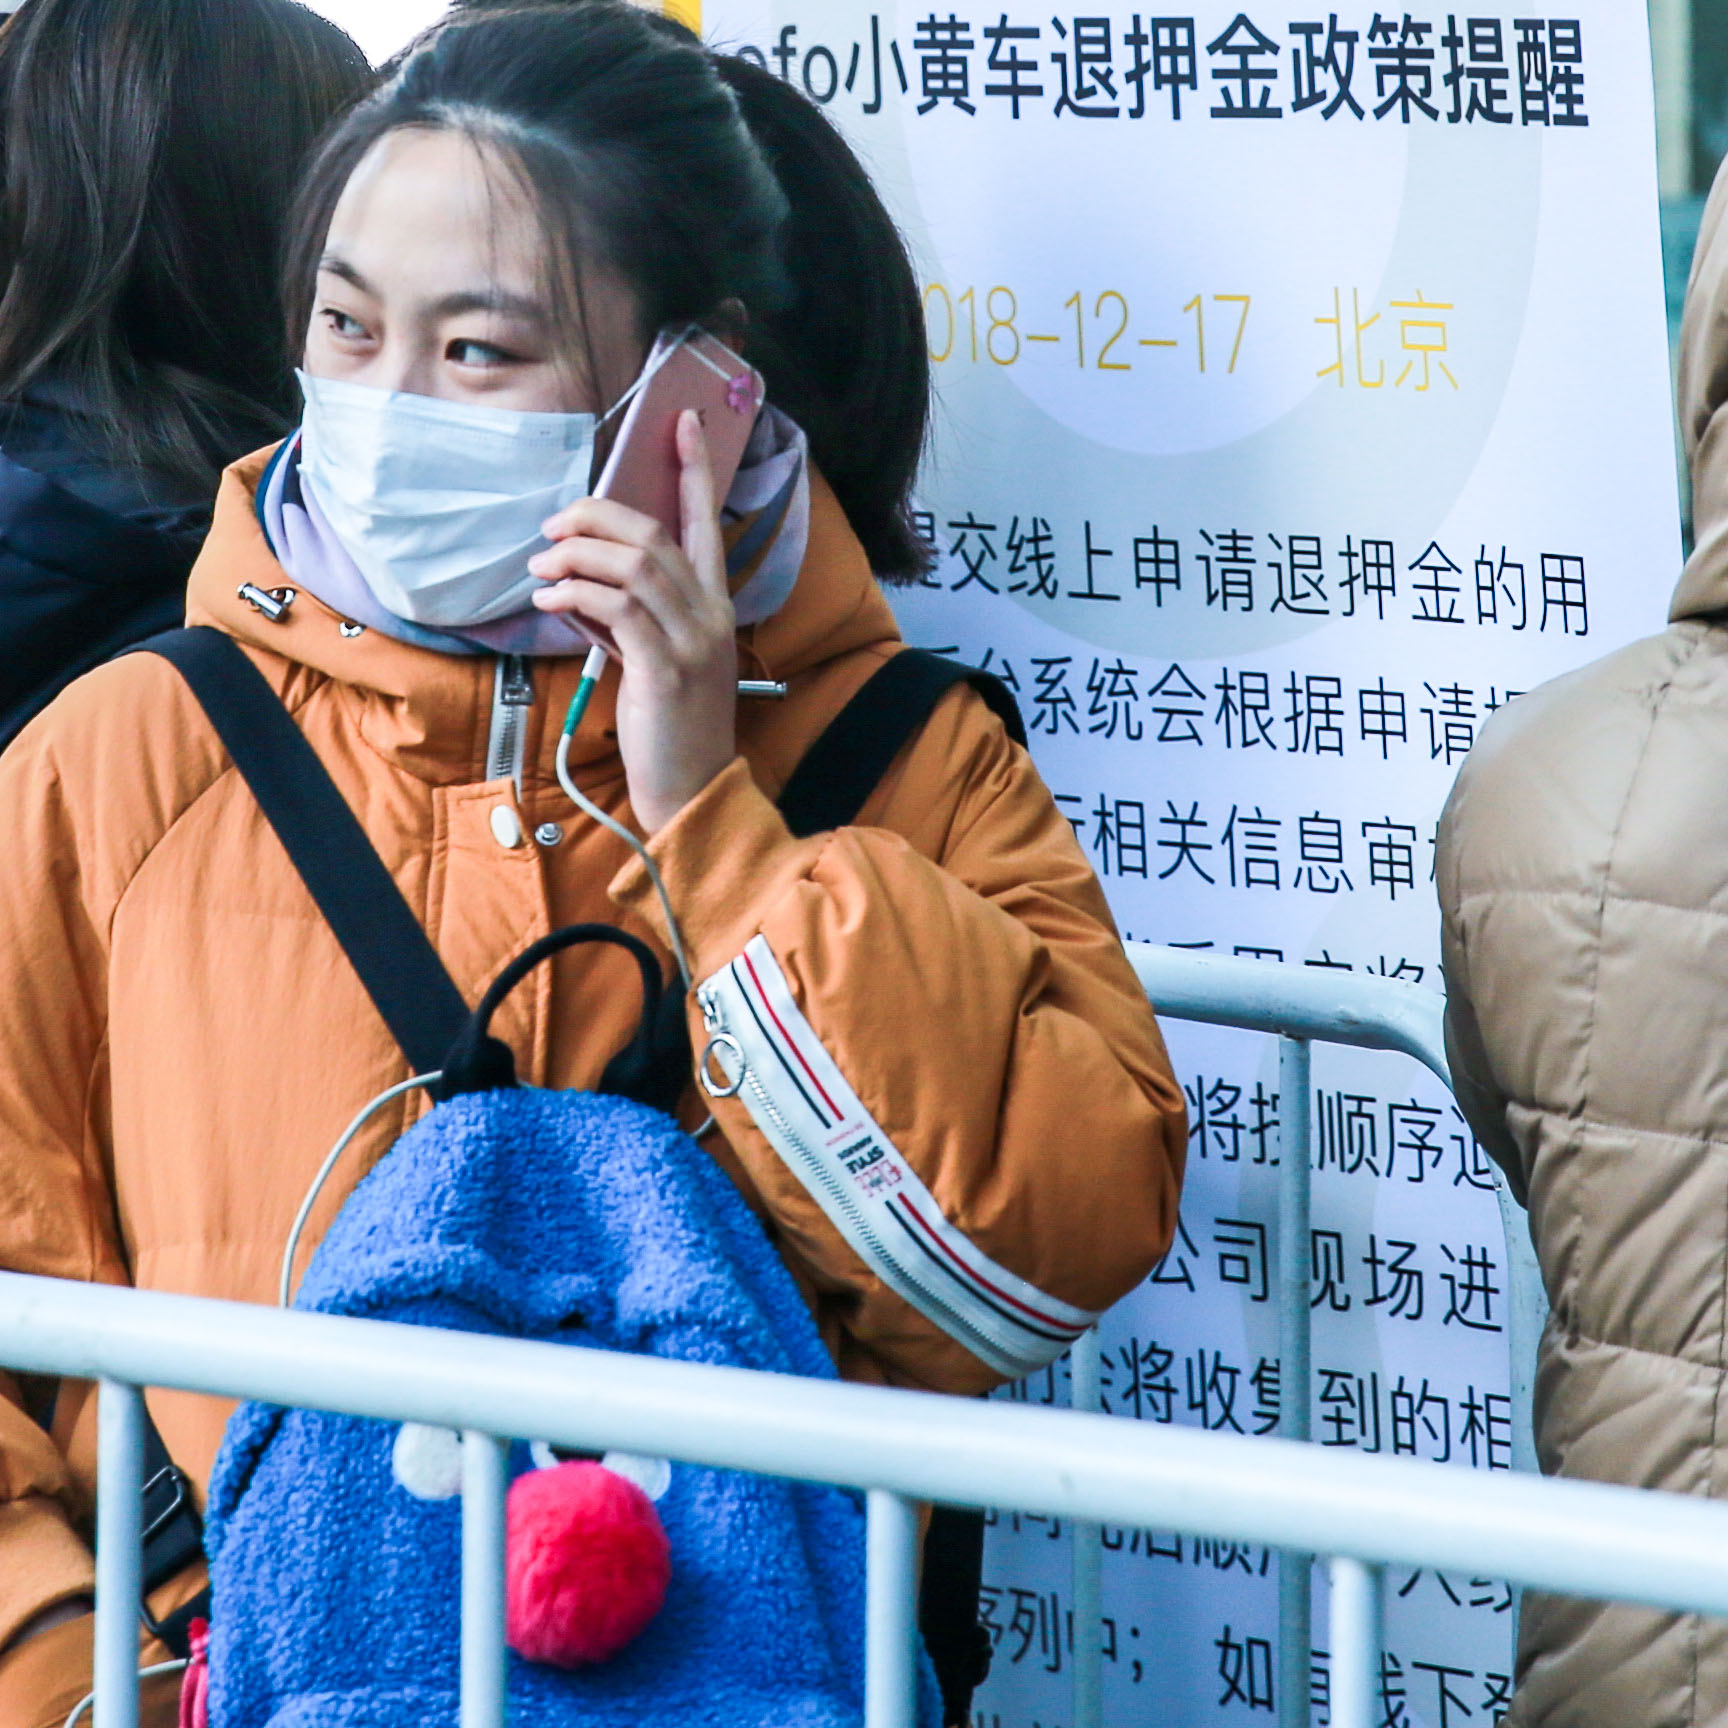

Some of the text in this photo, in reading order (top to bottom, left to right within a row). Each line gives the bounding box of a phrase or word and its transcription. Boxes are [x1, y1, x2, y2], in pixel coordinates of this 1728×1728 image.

[1314, 286, 1458, 390] 北京
[932, 645, 1528, 765] 系统会根据申请
[1054, 792, 1440, 901] 相关信息审
